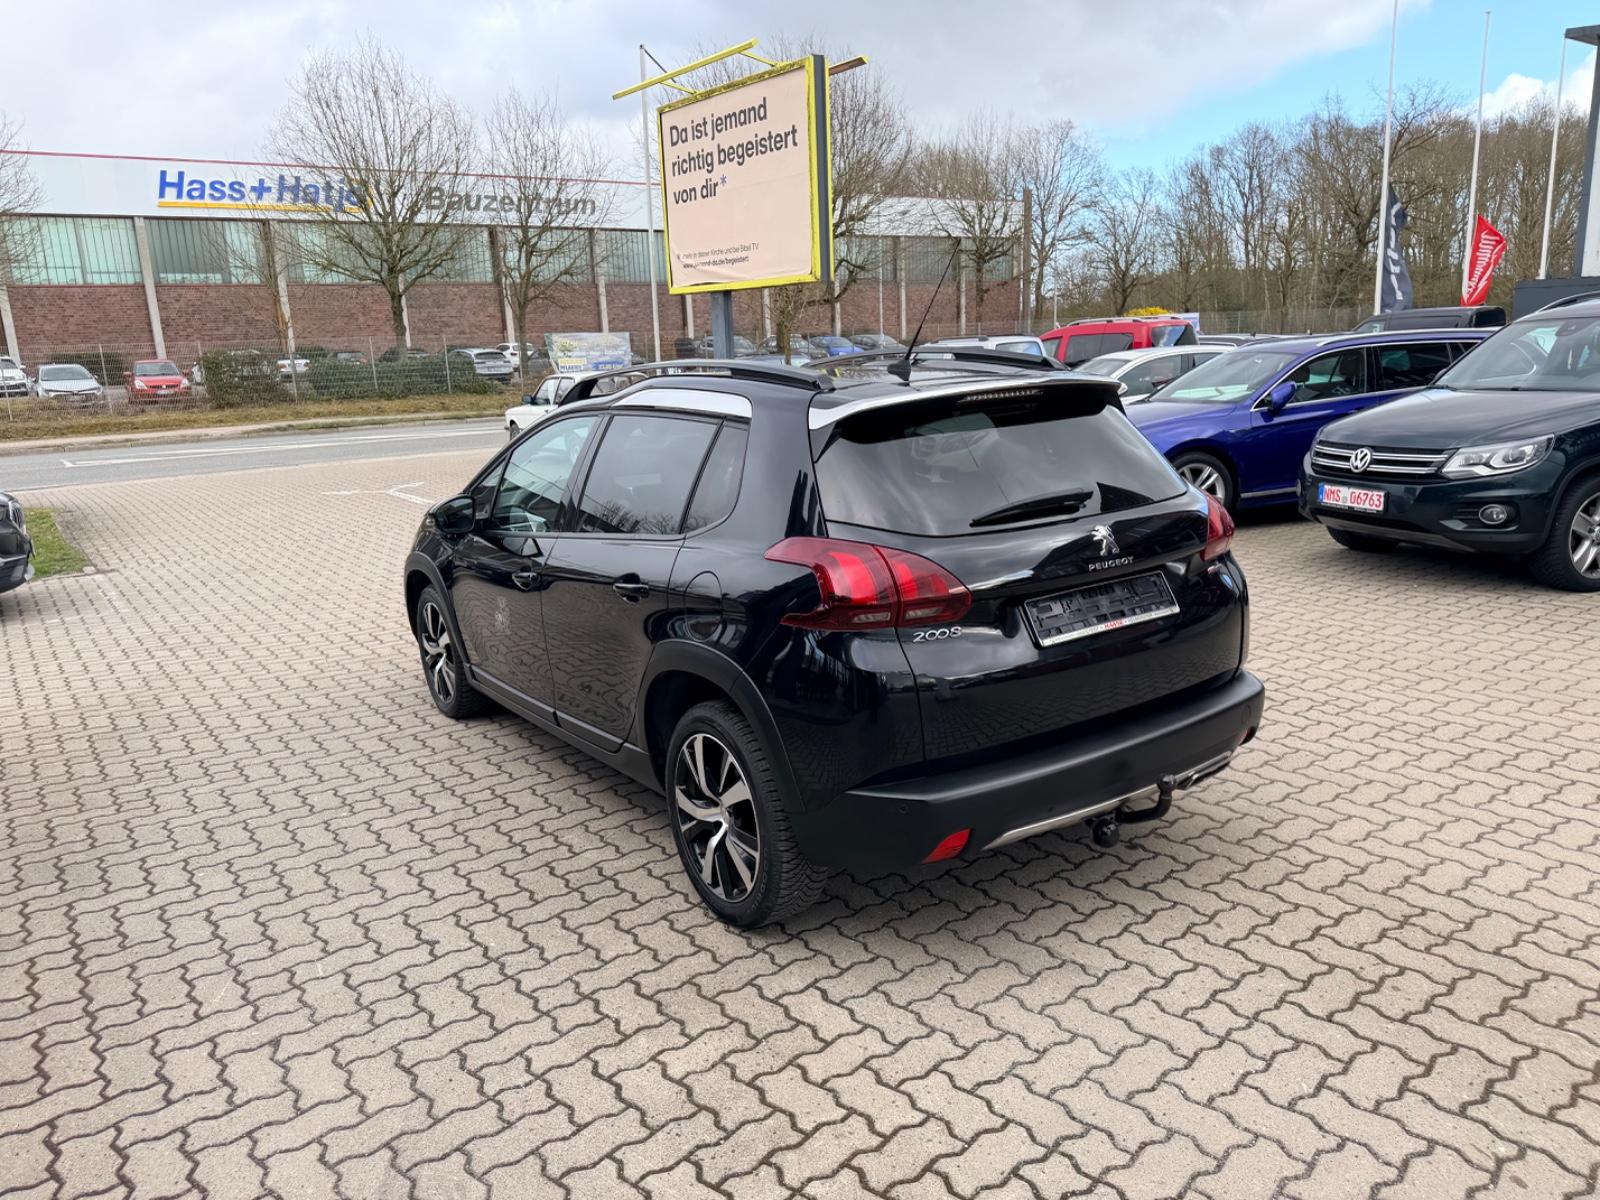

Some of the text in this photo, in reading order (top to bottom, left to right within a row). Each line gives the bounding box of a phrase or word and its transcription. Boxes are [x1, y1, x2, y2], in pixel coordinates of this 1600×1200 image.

[669, 96, 767, 147] Da ist jemand
[671, 124, 798, 177] richtig begeistert
[673, 186, 698, 205] von
[752, 242, 760, 251] TV
[1324, 488, 1342, 503] NMS
[1349, 490, 1383, 509] 06763
[1088, 556, 1134, 572] PEUGEOT
[912, 625, 962, 643] 2008
